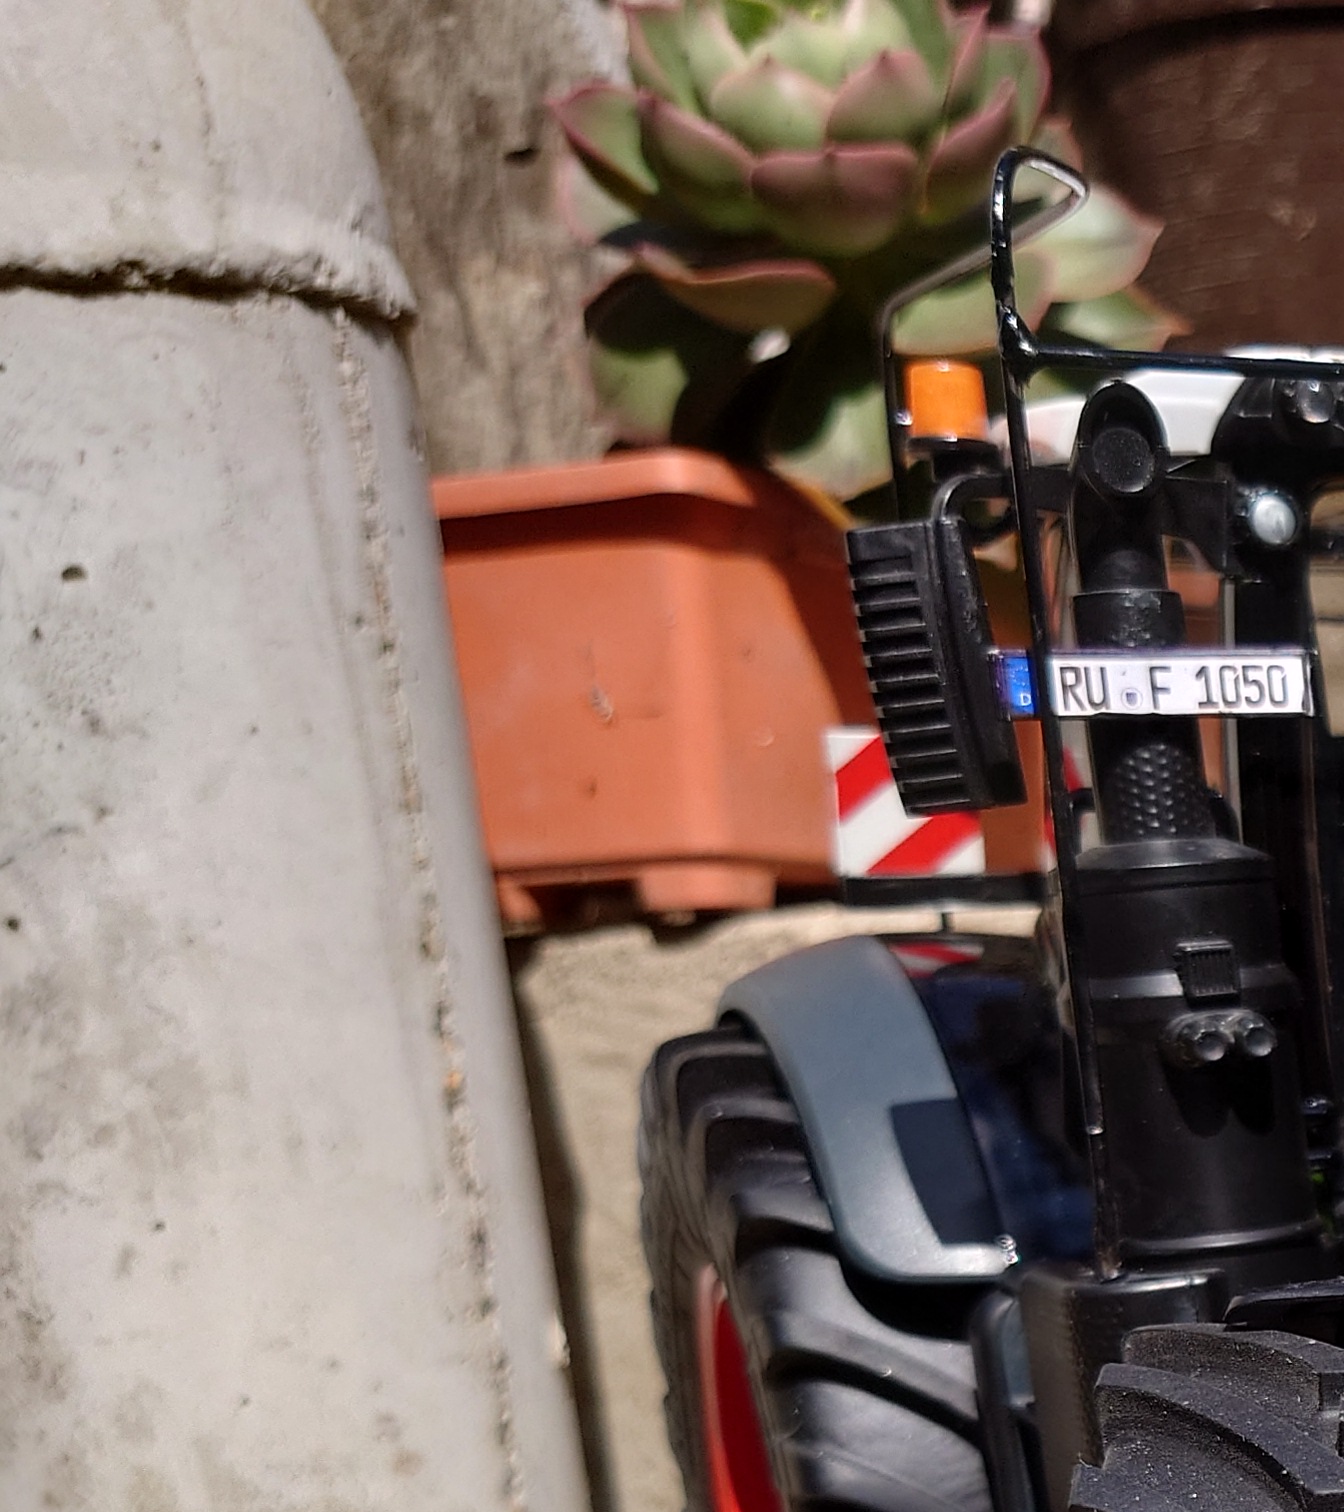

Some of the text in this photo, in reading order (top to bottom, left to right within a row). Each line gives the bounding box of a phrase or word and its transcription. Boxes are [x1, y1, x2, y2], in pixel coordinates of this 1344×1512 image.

[1019, 664, 1289, 711] D RU F 1050
